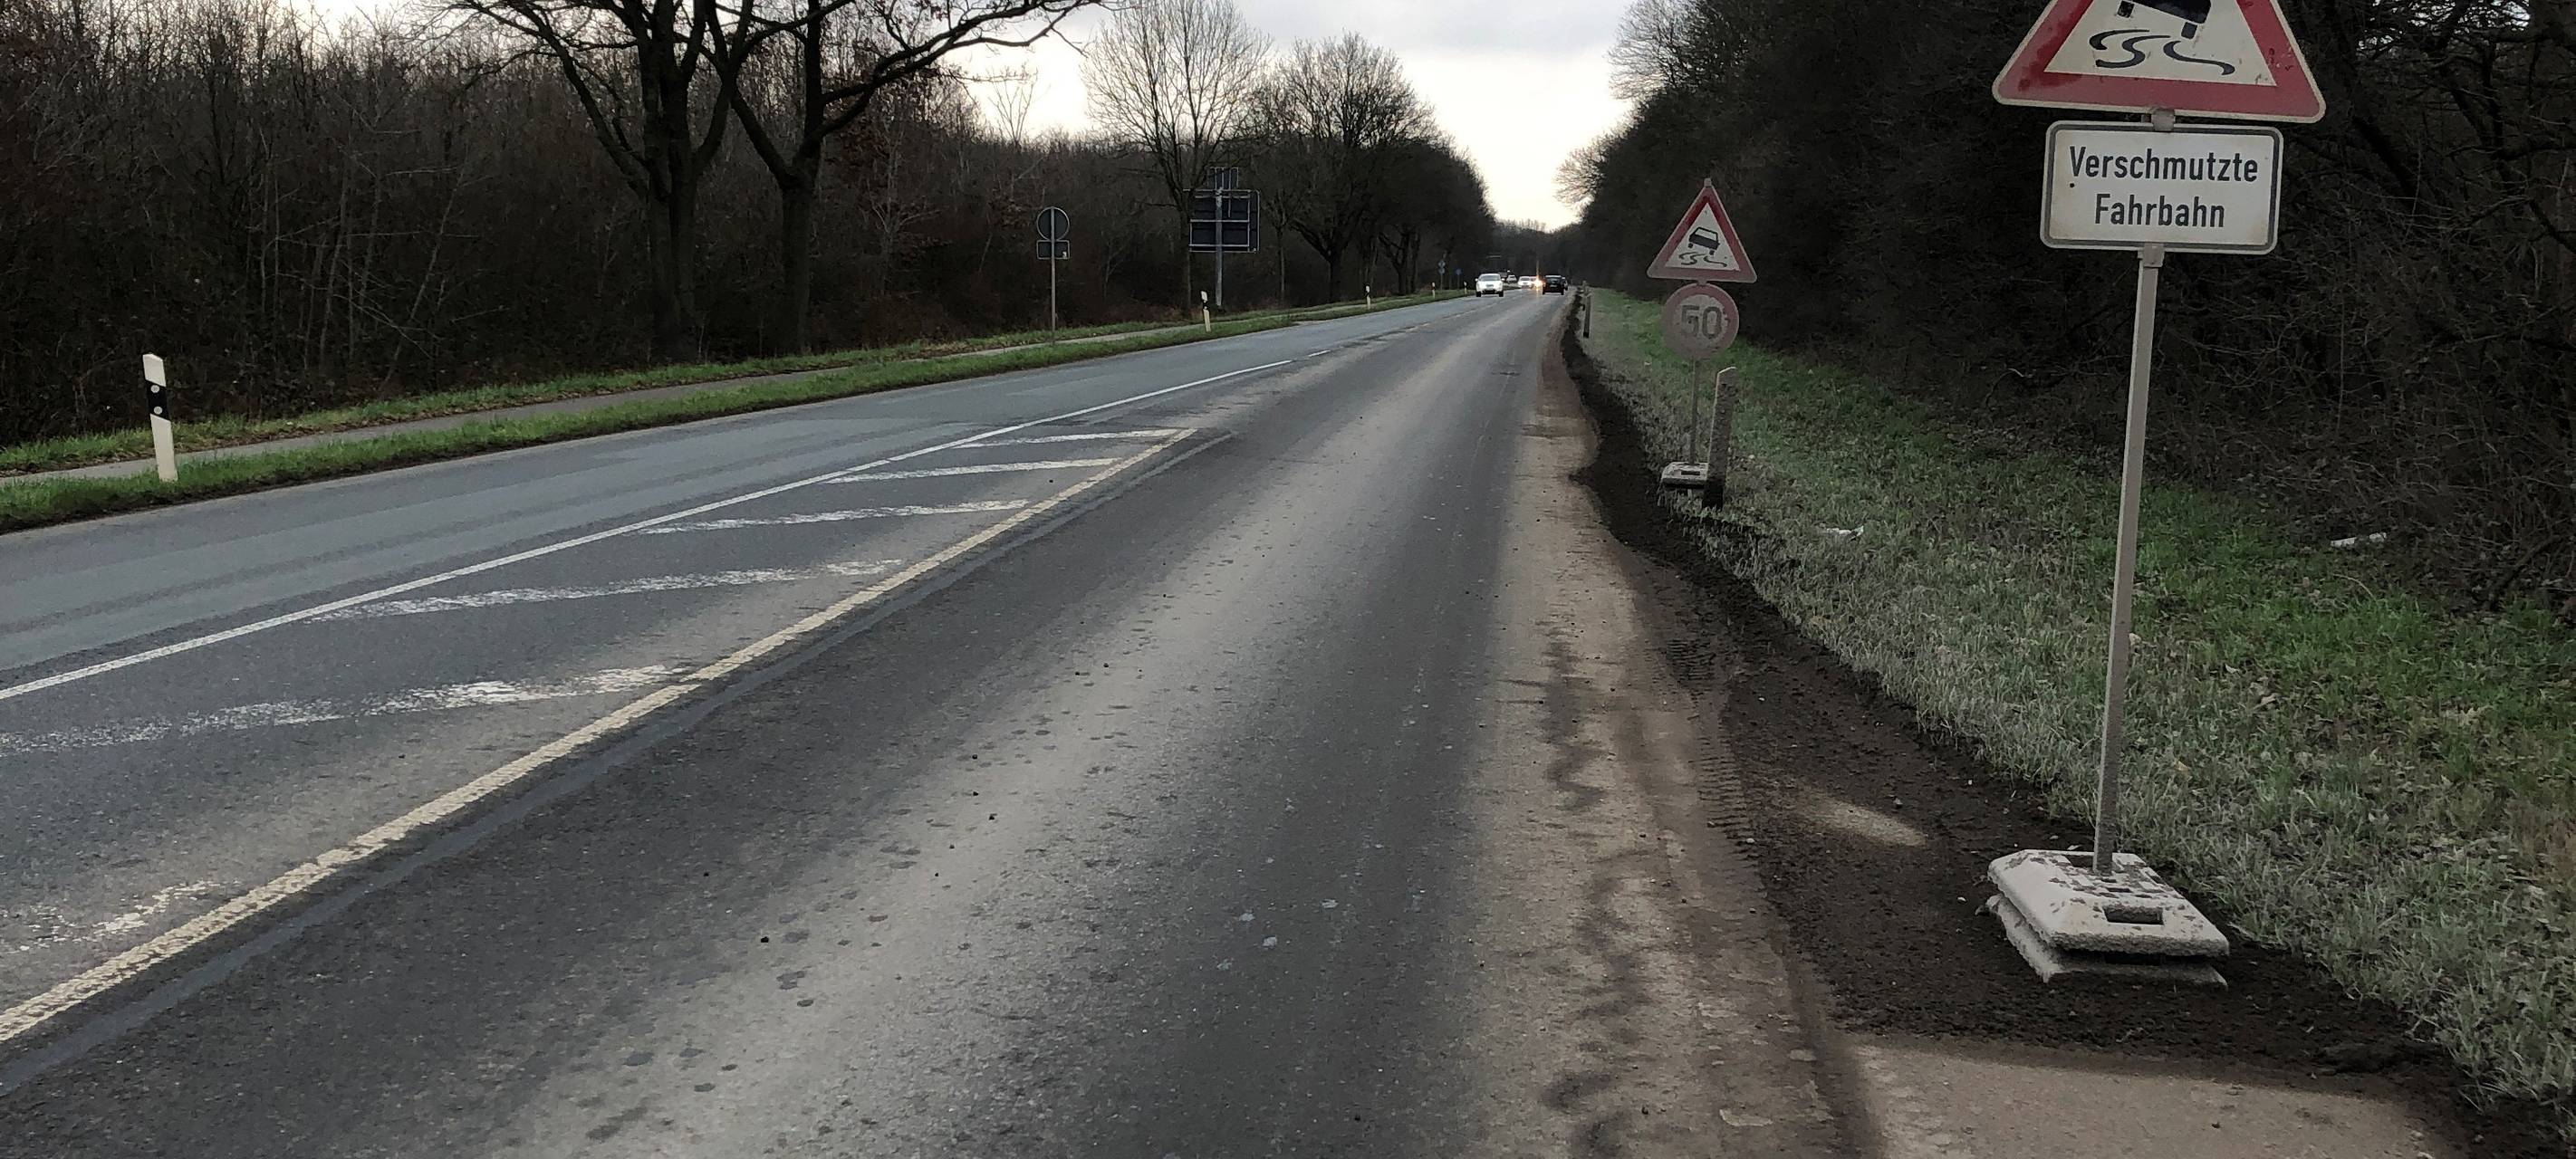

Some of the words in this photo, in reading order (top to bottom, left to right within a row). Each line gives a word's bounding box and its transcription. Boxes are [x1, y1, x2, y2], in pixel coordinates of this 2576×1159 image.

[2070, 146, 2258, 182] Verschmutzte
[2094, 193, 2225, 228] Fahrbahn
[1681, 304, 1722, 340] 50
